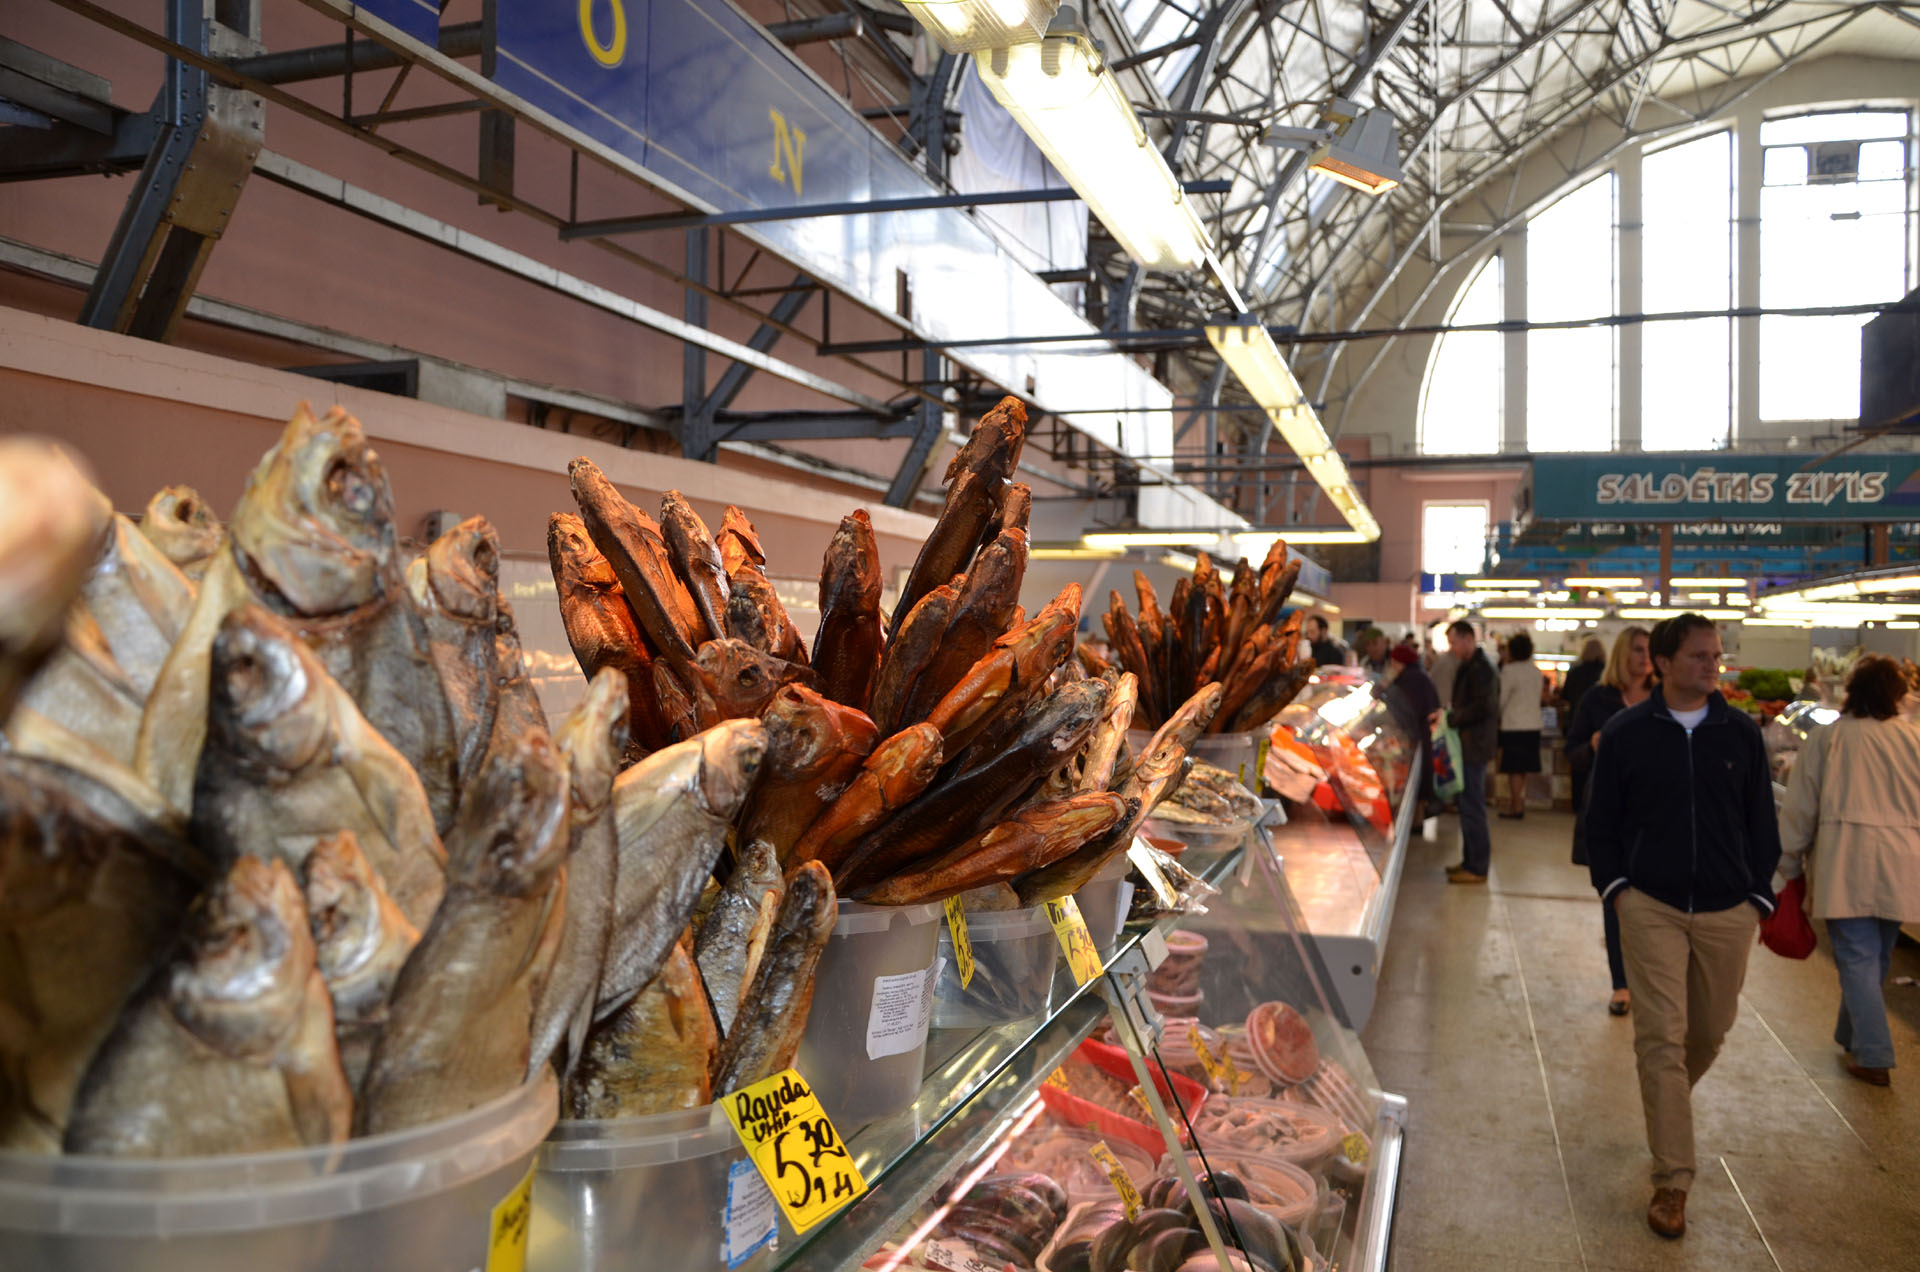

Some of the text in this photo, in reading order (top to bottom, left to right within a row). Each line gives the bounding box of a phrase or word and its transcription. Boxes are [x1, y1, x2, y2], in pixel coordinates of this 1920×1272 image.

[769, 108, 806, 196] N
[736, 1076, 811, 1130] Rauda
[774, 1131, 811, 1208] 5
